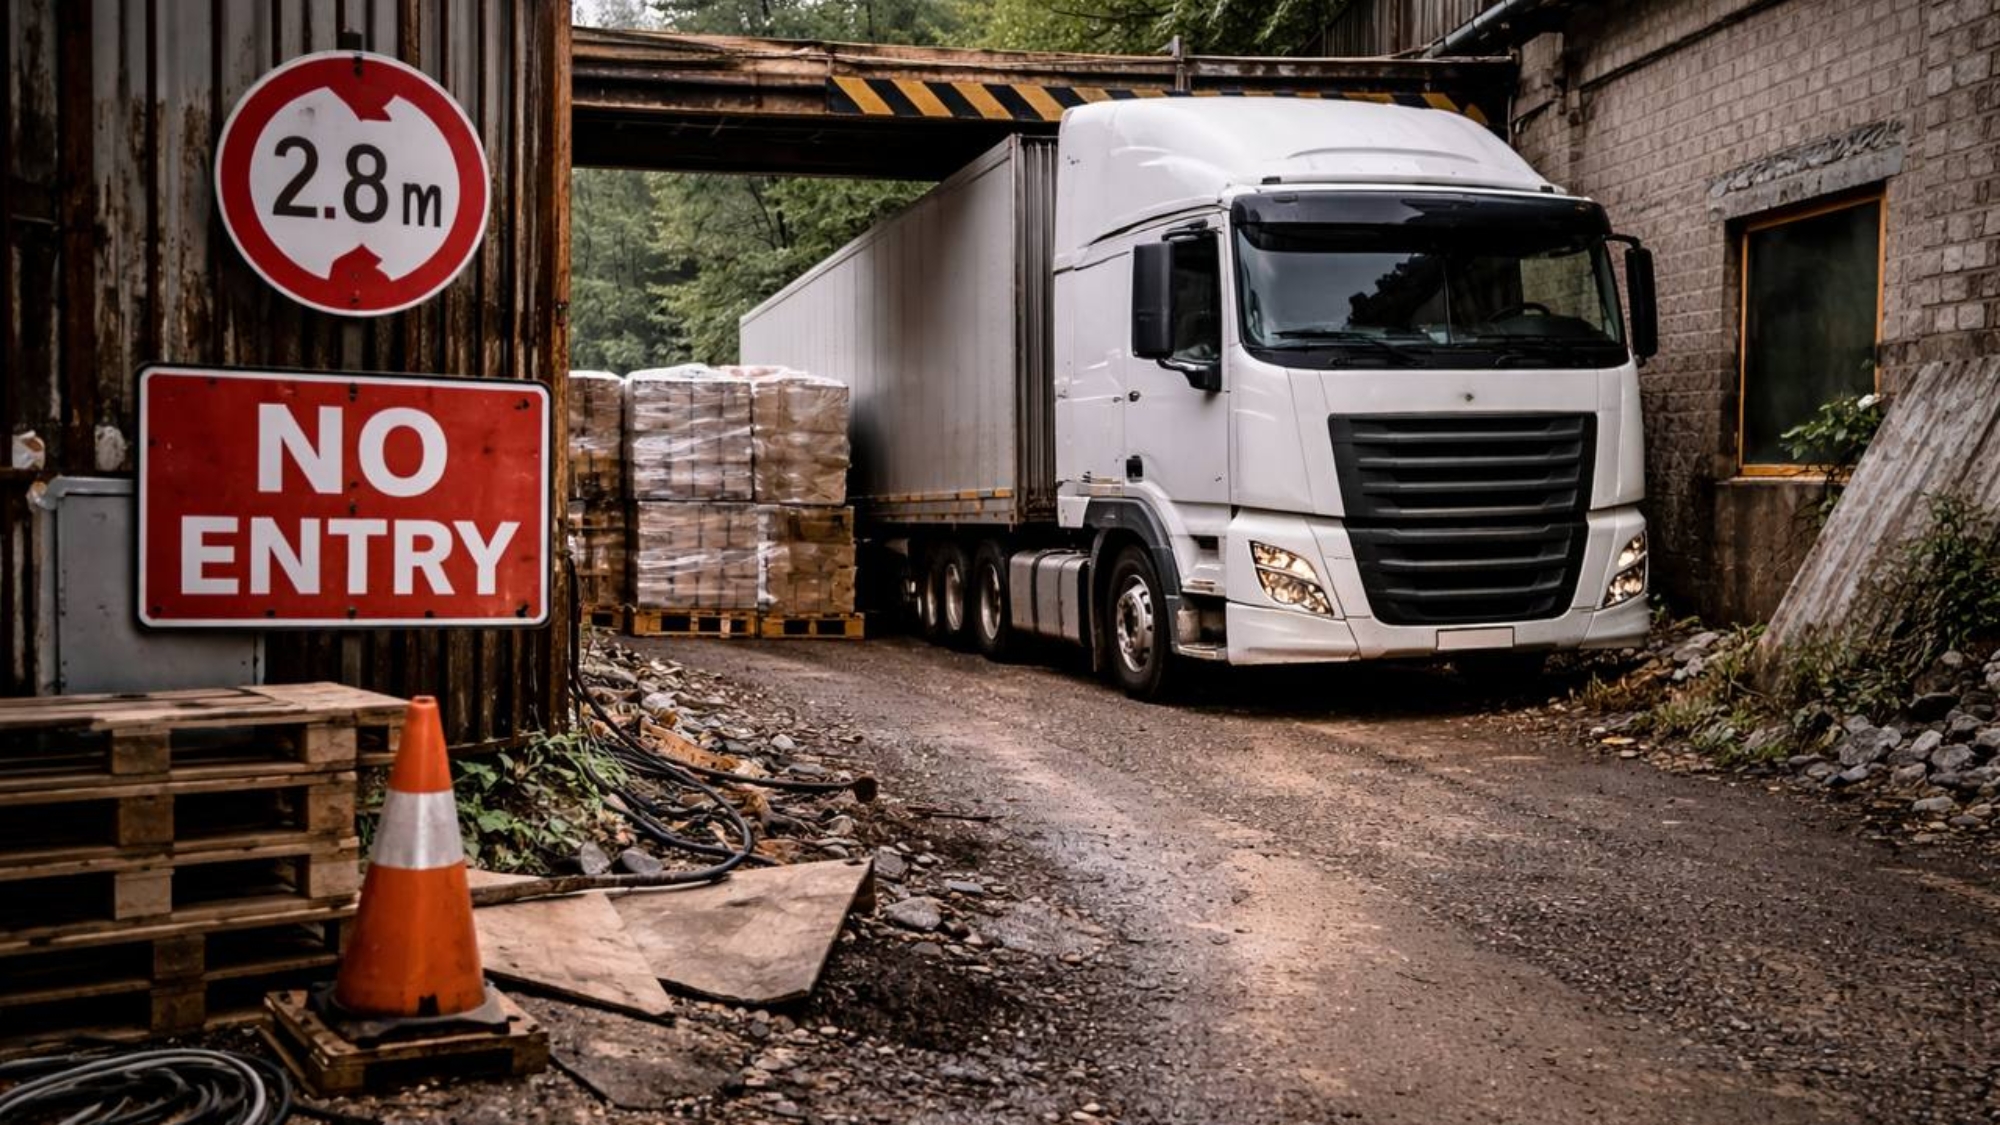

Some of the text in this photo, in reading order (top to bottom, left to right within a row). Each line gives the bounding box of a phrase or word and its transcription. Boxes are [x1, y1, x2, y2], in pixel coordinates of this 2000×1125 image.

[271, 136, 442, 228] 2.8 m
[258, 403, 448, 497] NO
[181, 516, 521, 596] ENTRY
